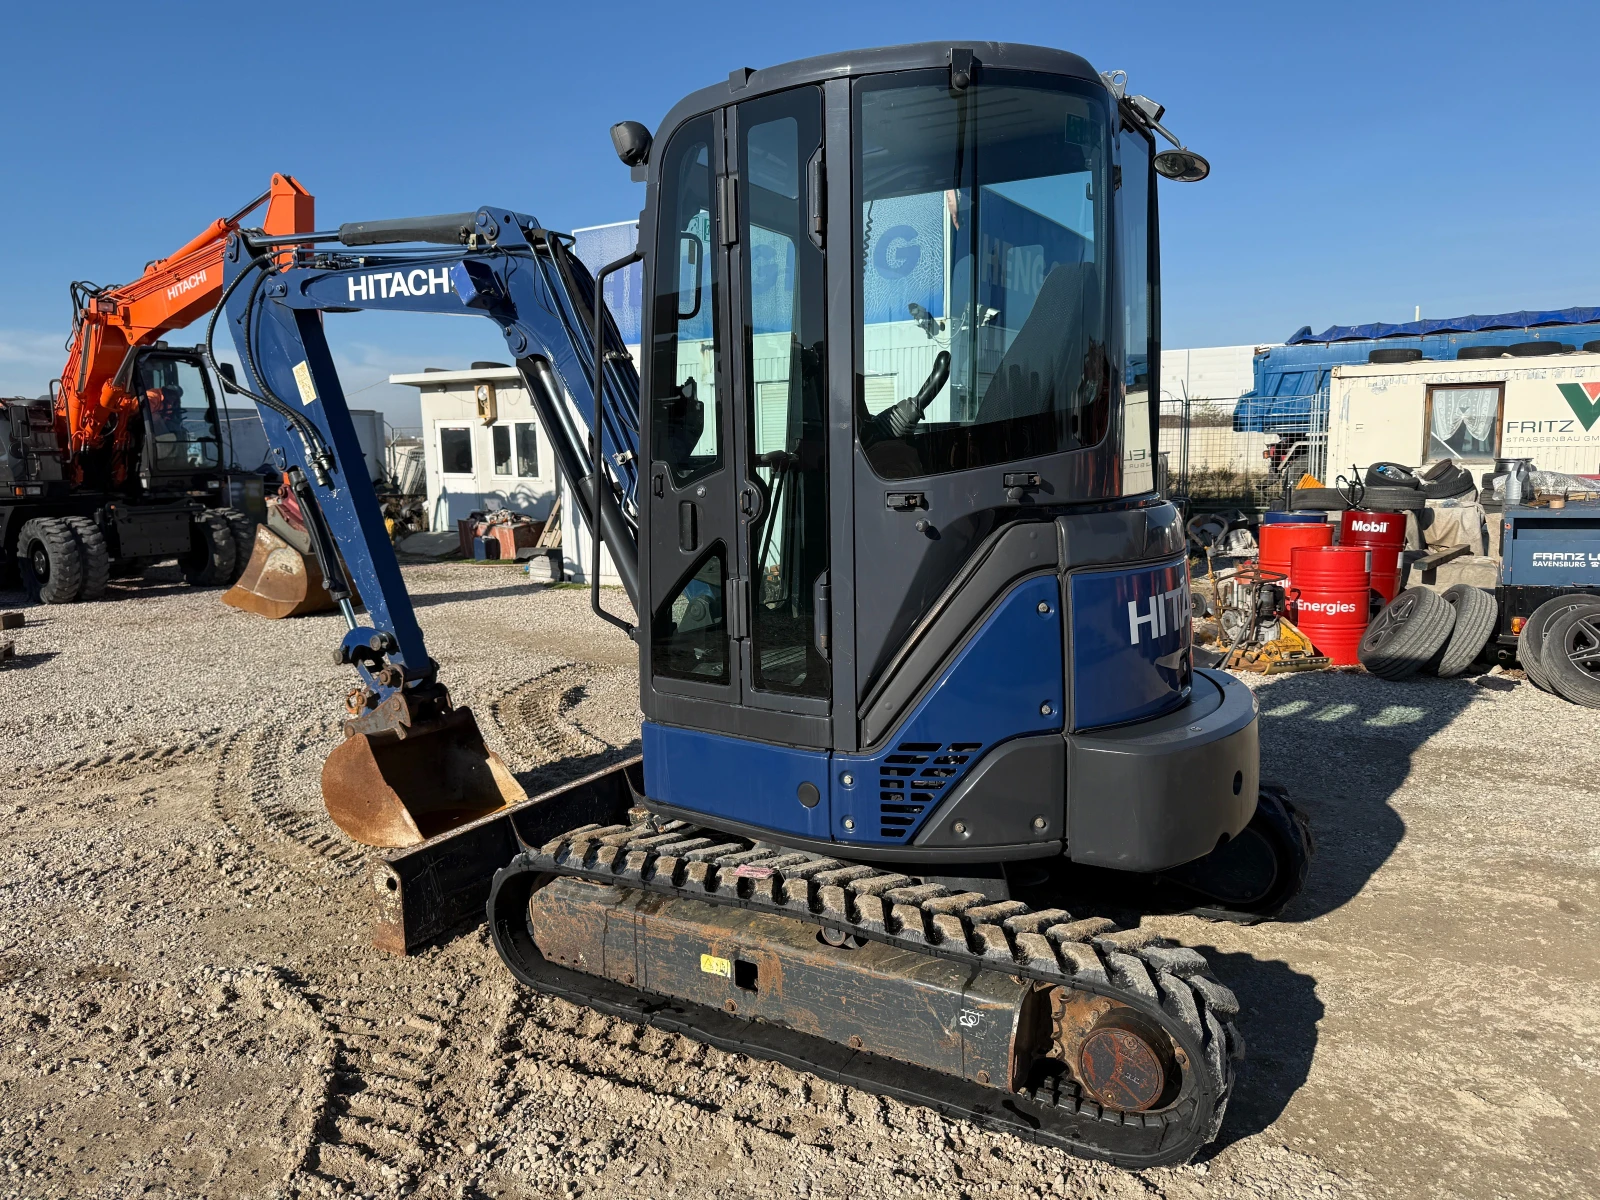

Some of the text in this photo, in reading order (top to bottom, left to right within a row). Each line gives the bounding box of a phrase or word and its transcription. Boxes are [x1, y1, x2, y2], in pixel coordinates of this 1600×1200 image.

[167, 270, 207, 301] HITACHI
[348, 267, 454, 301] HITACH
[1506, 420, 1574, 433] FRITZ
[1352, 520, 1388, 533] Mobil
[1532, 552, 1600, 561] FRANZ L
[1532, 560, 1587, 568] RAVENSBURG
[1297, 599, 1356, 615] Energies
